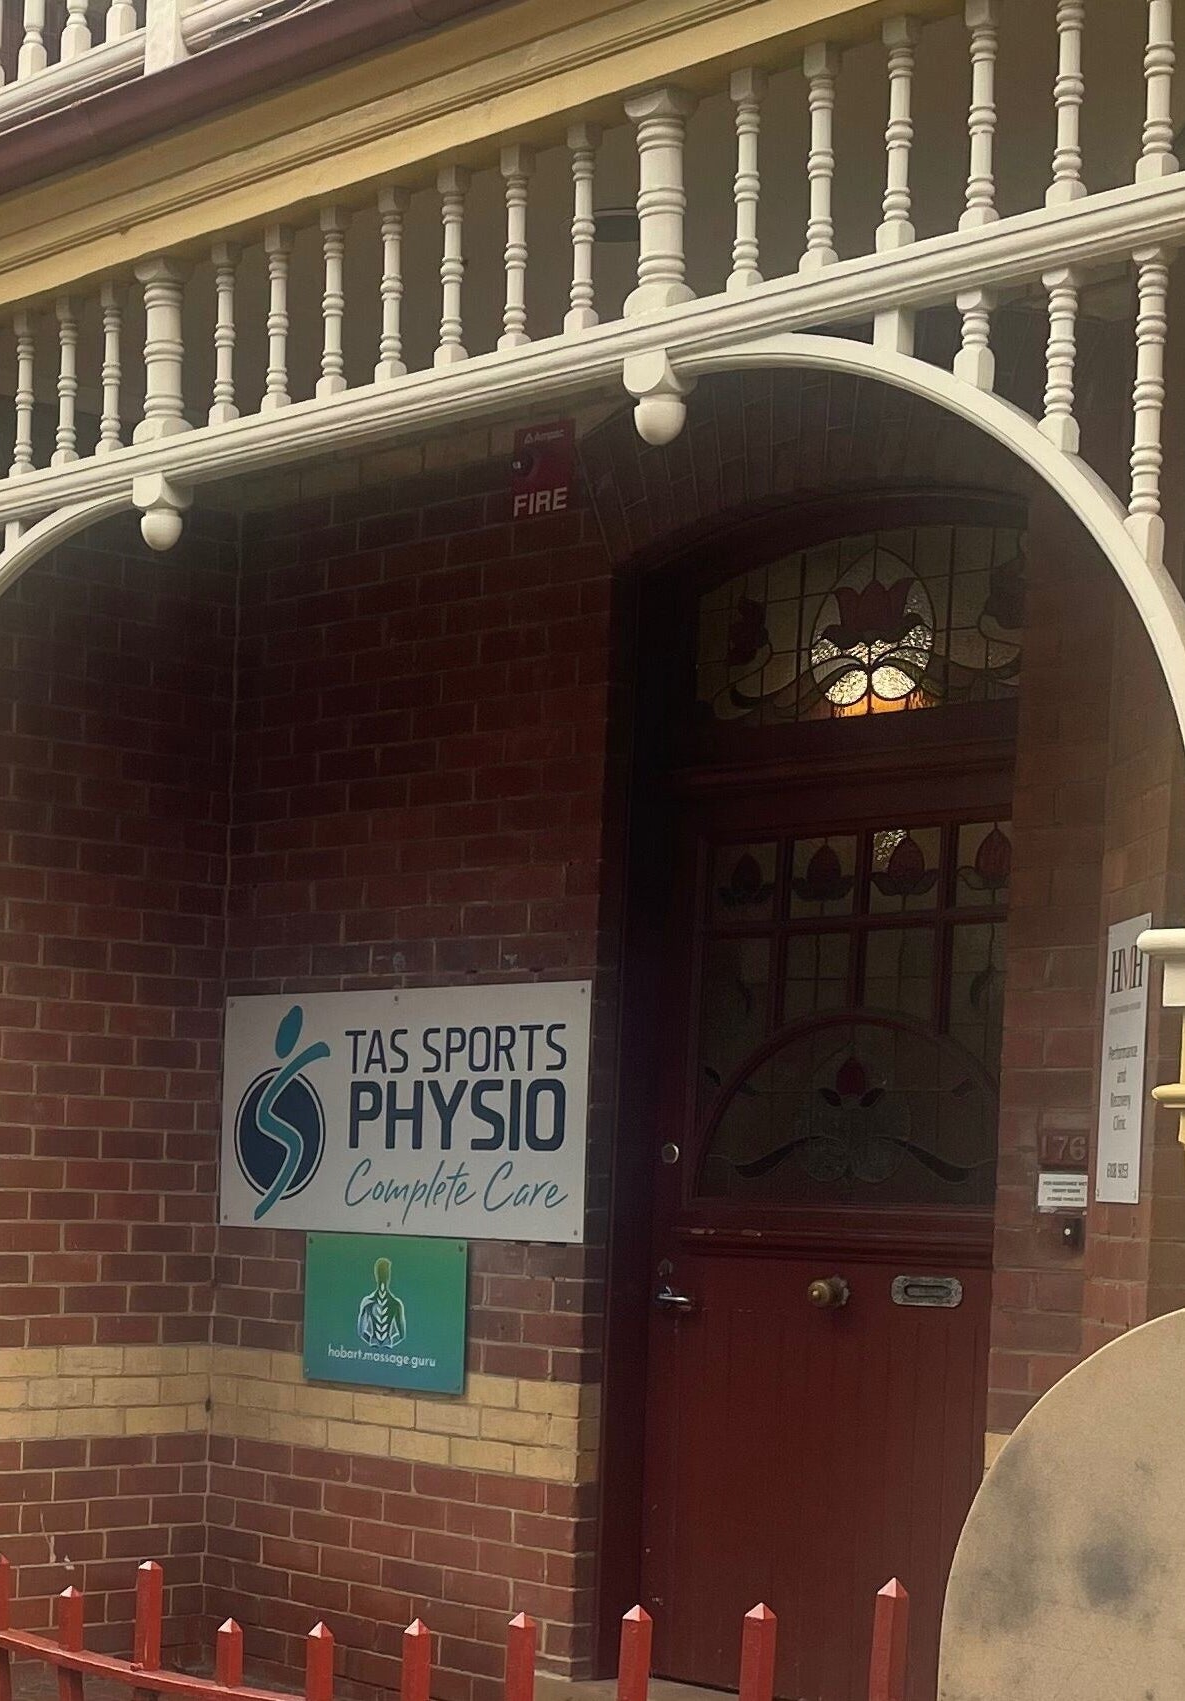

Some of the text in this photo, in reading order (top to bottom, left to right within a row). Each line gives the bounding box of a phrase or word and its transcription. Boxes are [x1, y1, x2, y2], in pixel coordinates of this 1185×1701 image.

[513, 486, 568, 517] FIRE
[345, 1023, 567, 1074] TAS SPORTS
[349, 1078, 566, 1151] PHYSIO
[1041, 1136, 1087, 1161] 176
[344, 1158, 569, 1225] Complete Care
[327, 1344, 437, 1369] hobart.massage.guru
